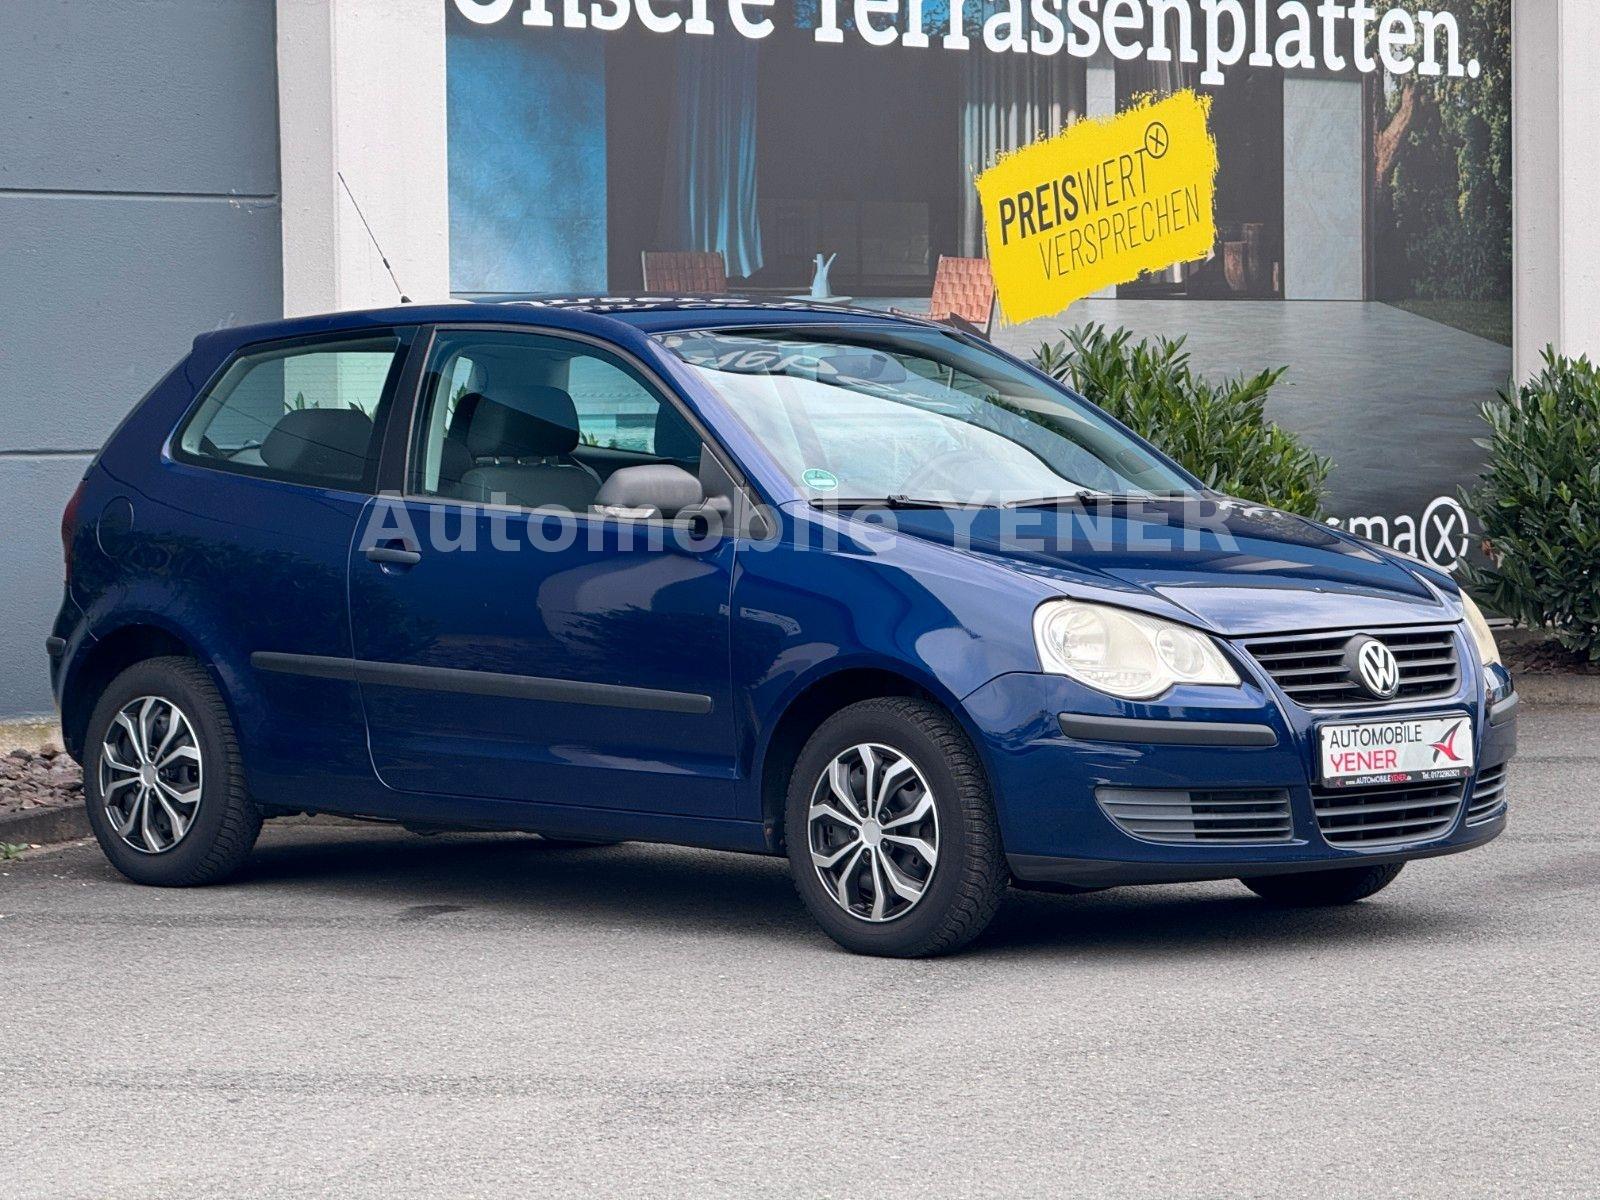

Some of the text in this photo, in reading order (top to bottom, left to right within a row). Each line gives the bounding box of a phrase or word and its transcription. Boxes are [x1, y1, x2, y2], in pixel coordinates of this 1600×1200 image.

[999, 148, 1148, 246] PREISWERT
[1040, 184, 1200, 280] VERSPRECHEN
[1329, 725, 1422, 749] AUTOMOBILE
[1330, 749, 1398, 773] YENER
